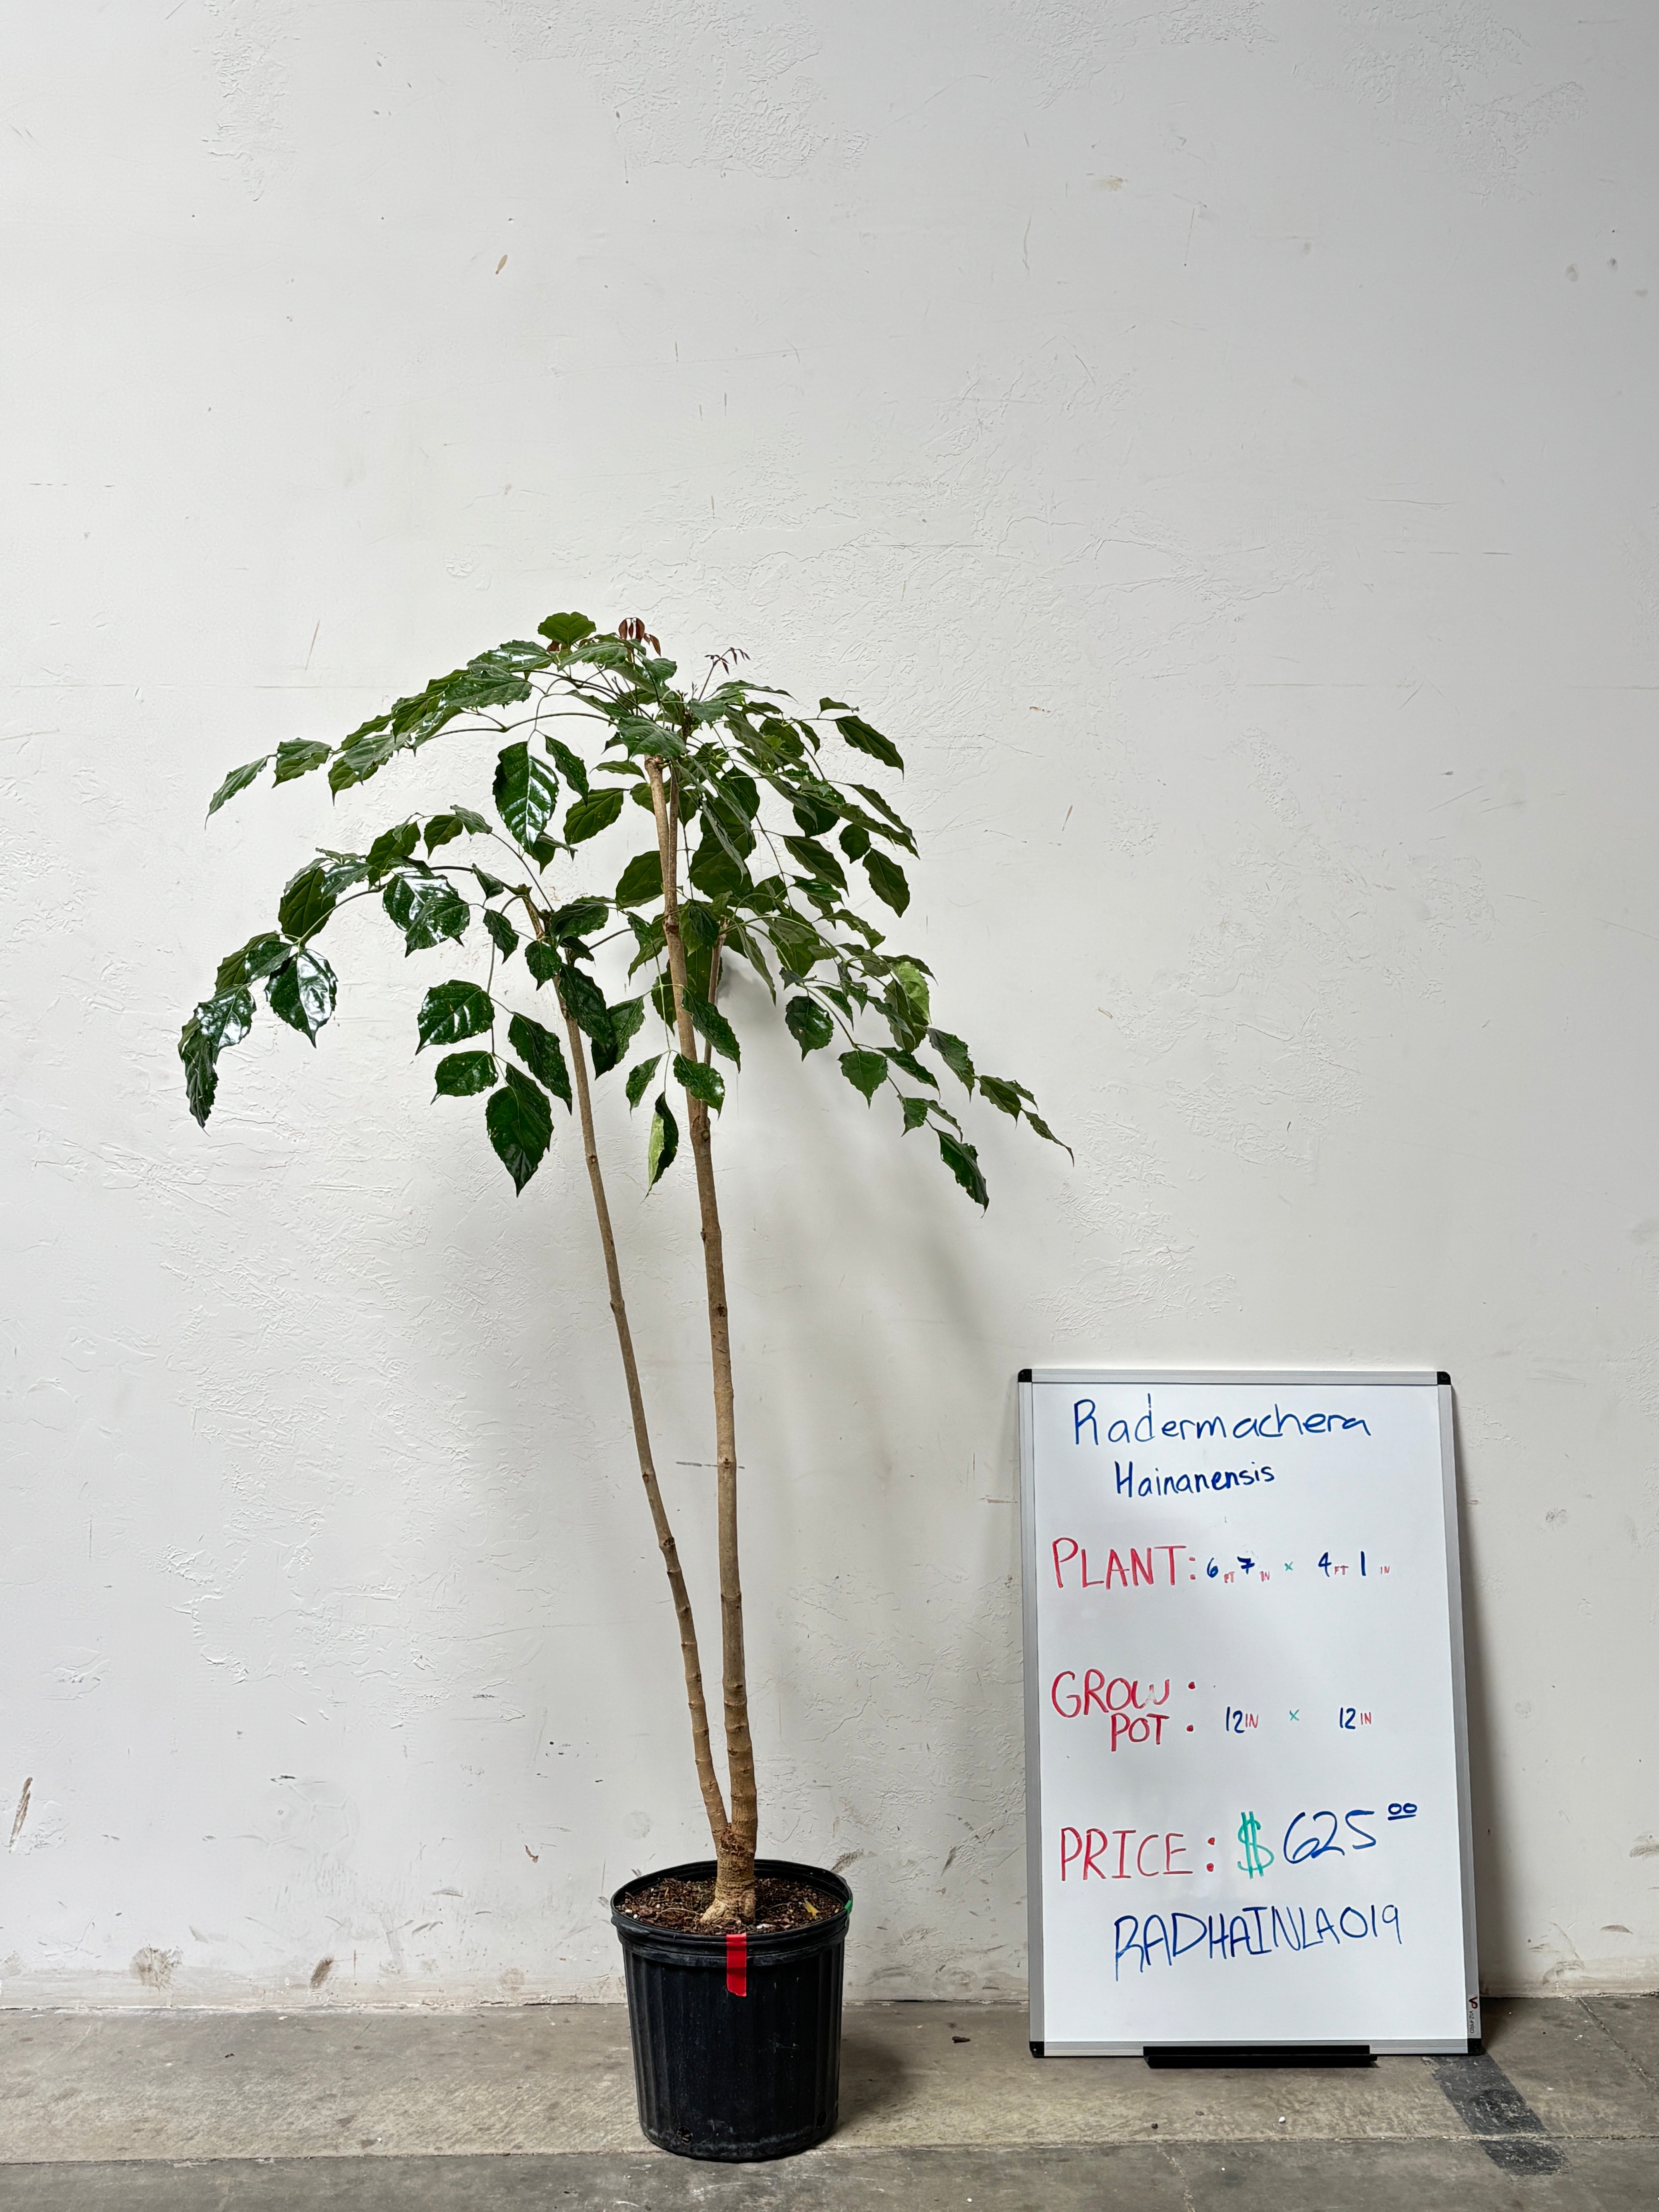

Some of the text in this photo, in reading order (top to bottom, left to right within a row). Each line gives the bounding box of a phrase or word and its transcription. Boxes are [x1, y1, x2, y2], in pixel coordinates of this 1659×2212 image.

[1073, 1392, 1372, 1446] Radermachera
[1114, 1460, 1275, 1498] Hainanensis
[1051, 1537, 1196, 1589] PLANT:
